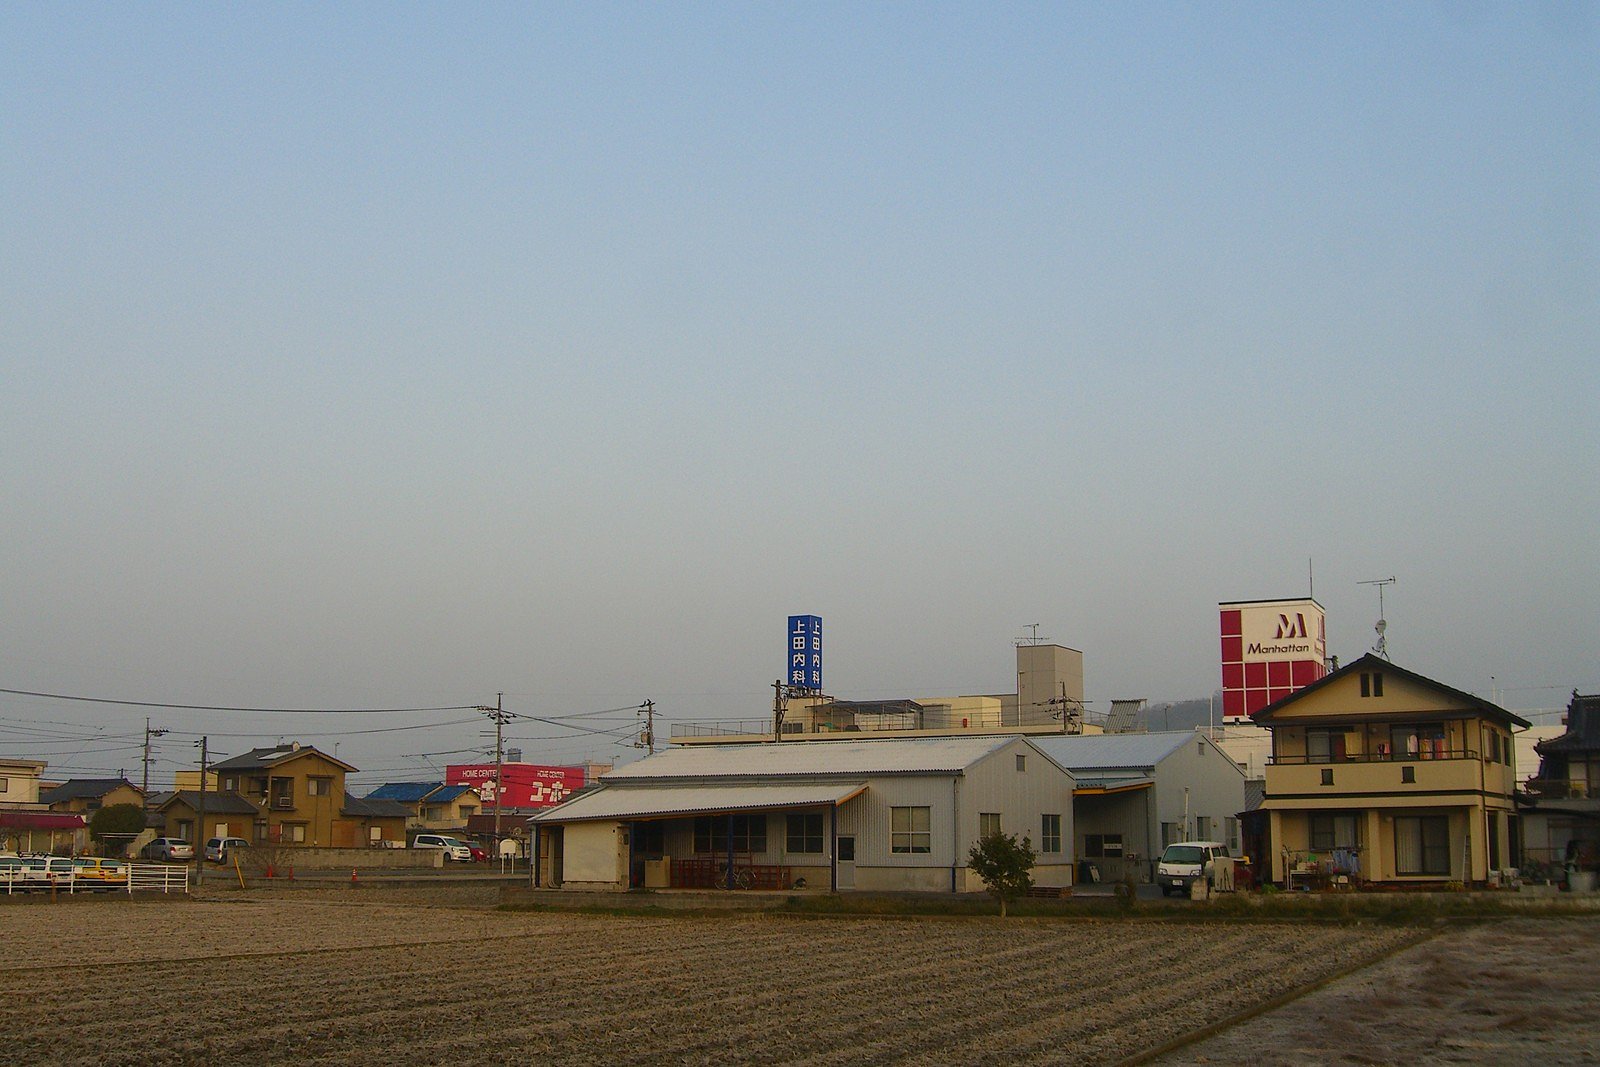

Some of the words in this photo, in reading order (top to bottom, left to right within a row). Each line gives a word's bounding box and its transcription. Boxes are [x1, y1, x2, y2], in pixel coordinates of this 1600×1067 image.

[793, 620, 805, 684] 上田内科
[1247, 643, 1309, 655] Manhattan
[462, 770, 478, 778] HOME
[478, 770, 498, 778] CENTE
[530, 781, 571, 802] ユーホー
